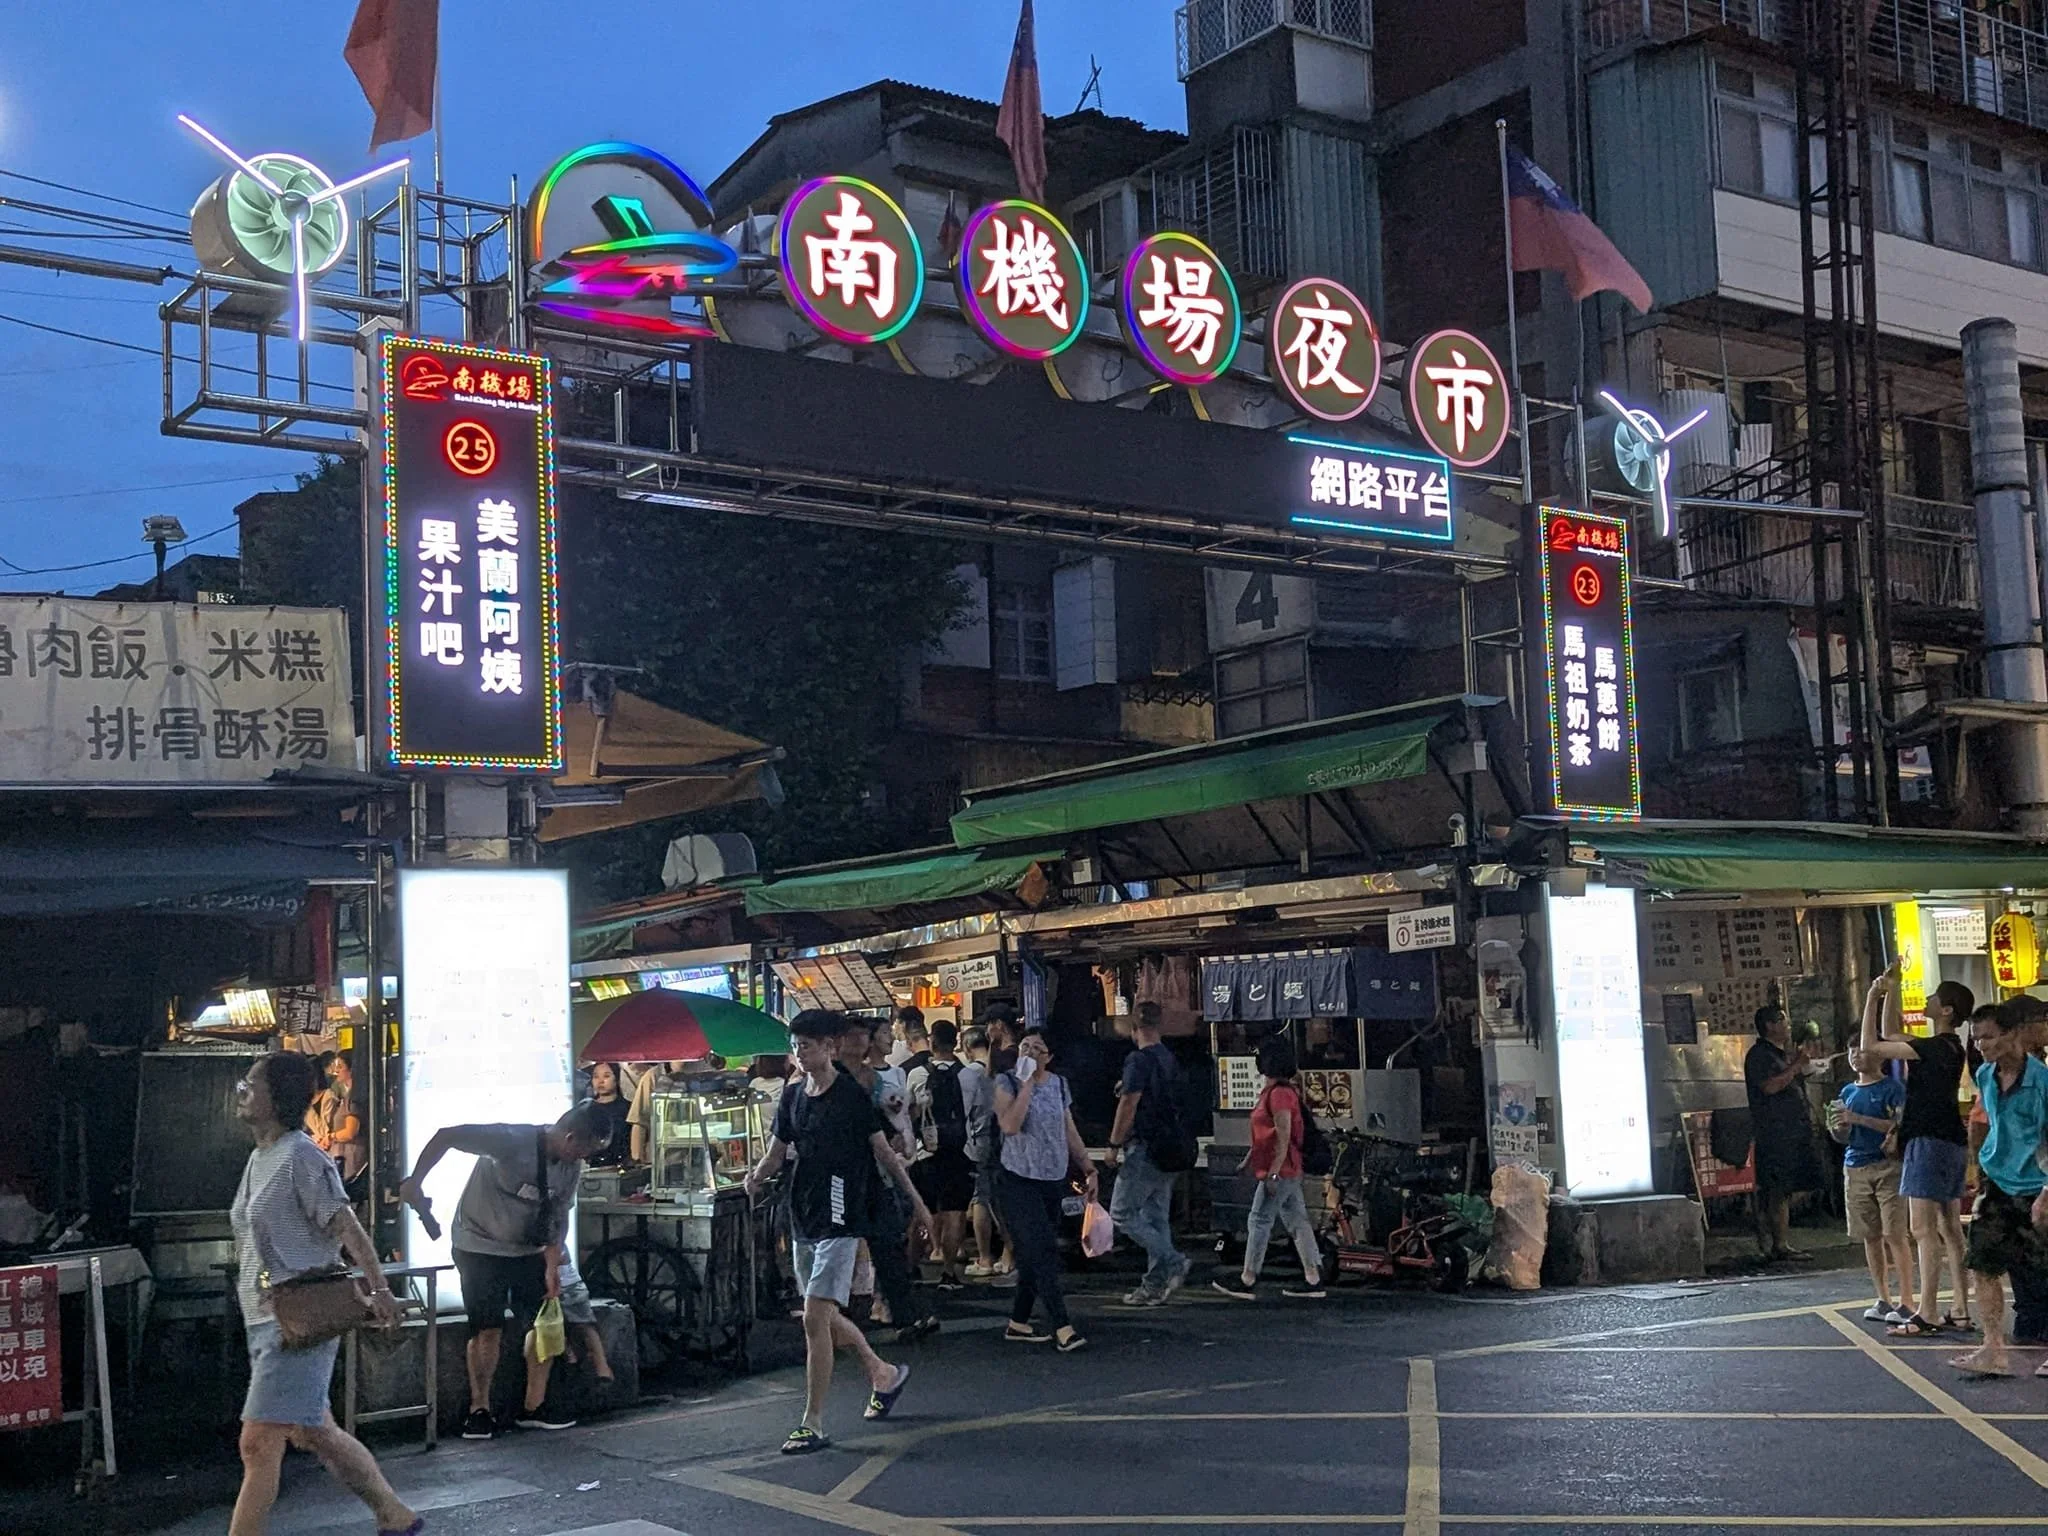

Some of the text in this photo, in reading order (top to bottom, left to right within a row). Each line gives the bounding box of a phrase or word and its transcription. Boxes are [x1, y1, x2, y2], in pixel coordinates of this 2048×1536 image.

[804, 191, 1493, 453] 南機場夜市
[453, 366, 531, 400] 南機場
[454, 436, 490, 462] 25
[1310, 455, 1450, 518] 網路平台
[418, 518, 465, 667] 果汁吧
[477, 498, 523, 696] 美蘭阿姨
[1235, 571, 1279, 631] 4
[1578, 577, 1597, 595] 23
[208, 628, 325, 682] 米糕
[1563, 624, 1592, 767] 馬祖奶茶
[86, 705, 329, 761] 排骨酥湯
[831, 1175, 846, 1226] PUMA
